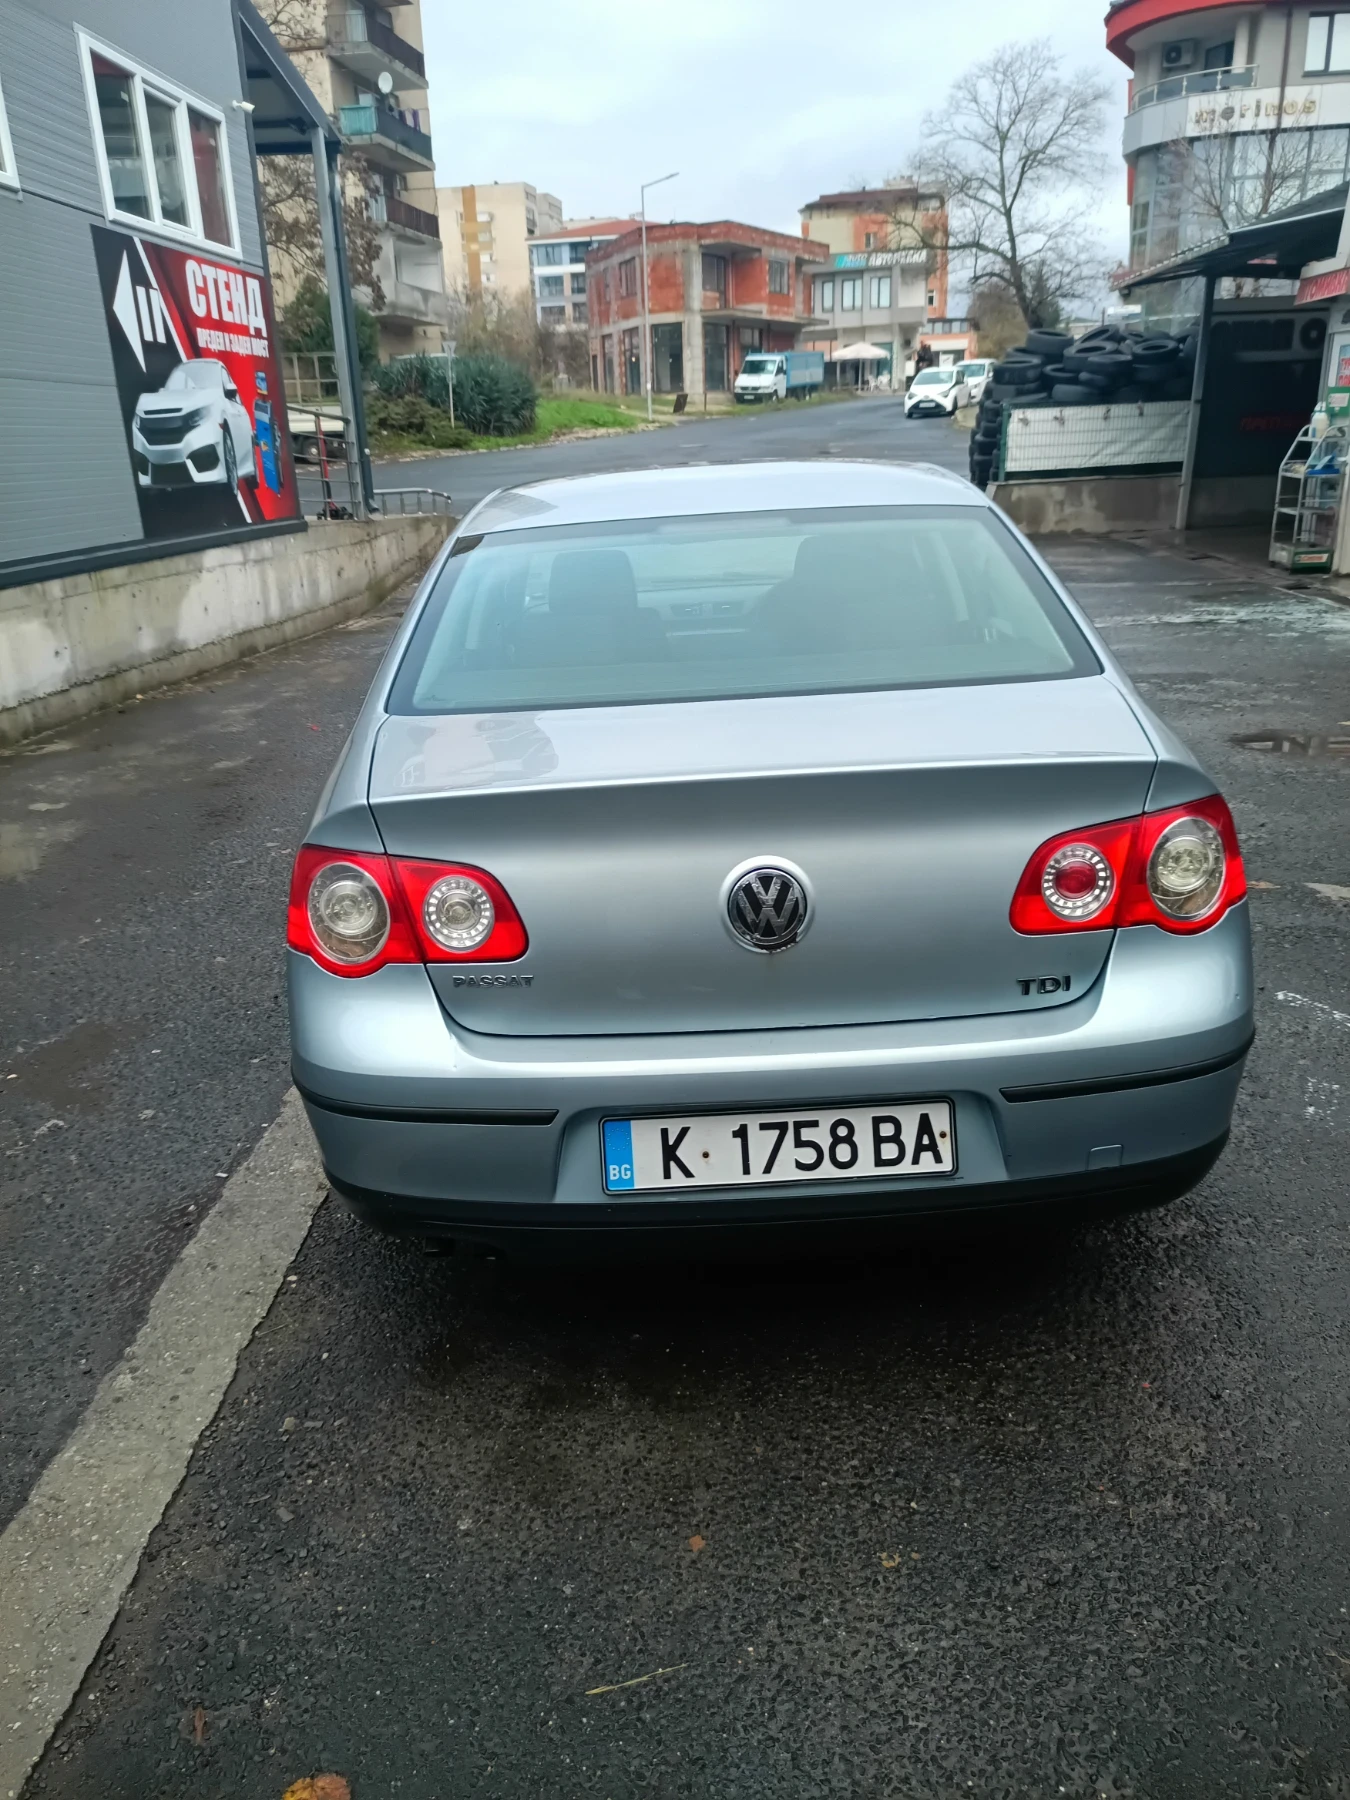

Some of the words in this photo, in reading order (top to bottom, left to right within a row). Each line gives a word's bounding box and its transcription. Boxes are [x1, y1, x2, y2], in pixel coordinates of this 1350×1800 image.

[185, 259, 268, 338] СТЕНД
[223, 332, 232, 352] И
[250, 337, 269, 359] МОСТ
[452, 974, 534, 989] PASSAT
[1016, 974, 1071, 996] TDI
[660, 1126, 695, 1179] K
[609, 1164, 631, 1180] BG
